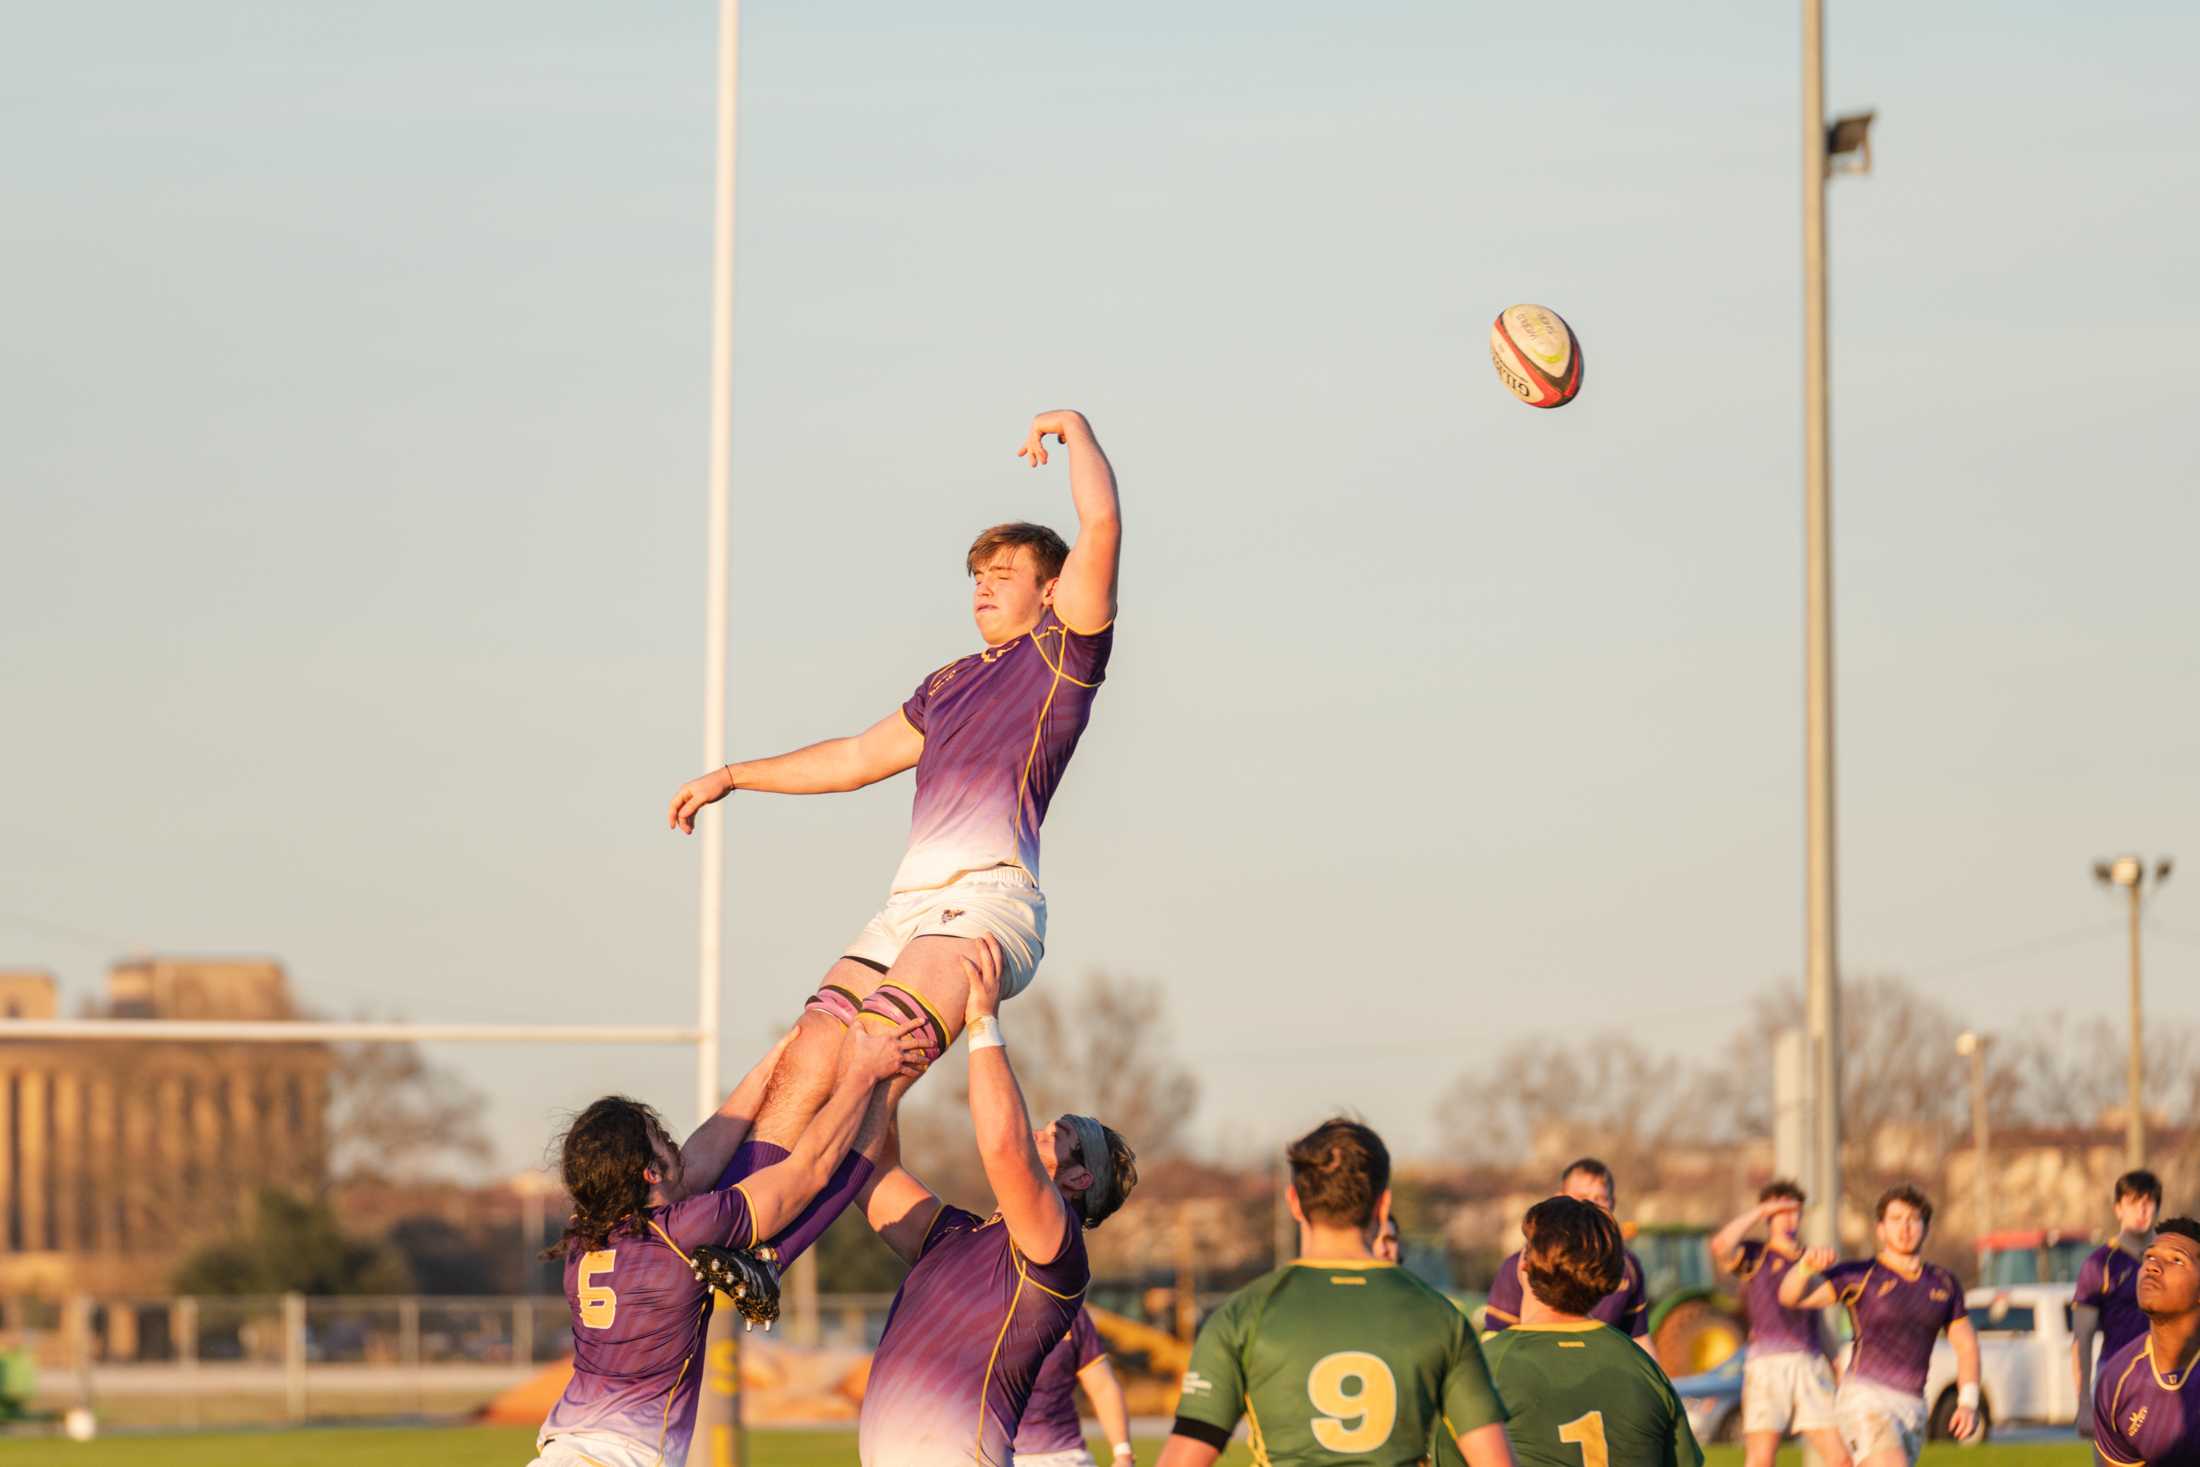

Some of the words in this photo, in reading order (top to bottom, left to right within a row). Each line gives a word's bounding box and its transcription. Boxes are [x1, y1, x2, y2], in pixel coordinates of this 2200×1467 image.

[577, 1248, 617, 1330] 6
[1308, 1350, 1398, 1454] 9
[1557, 1410, 1609, 1467] 1
